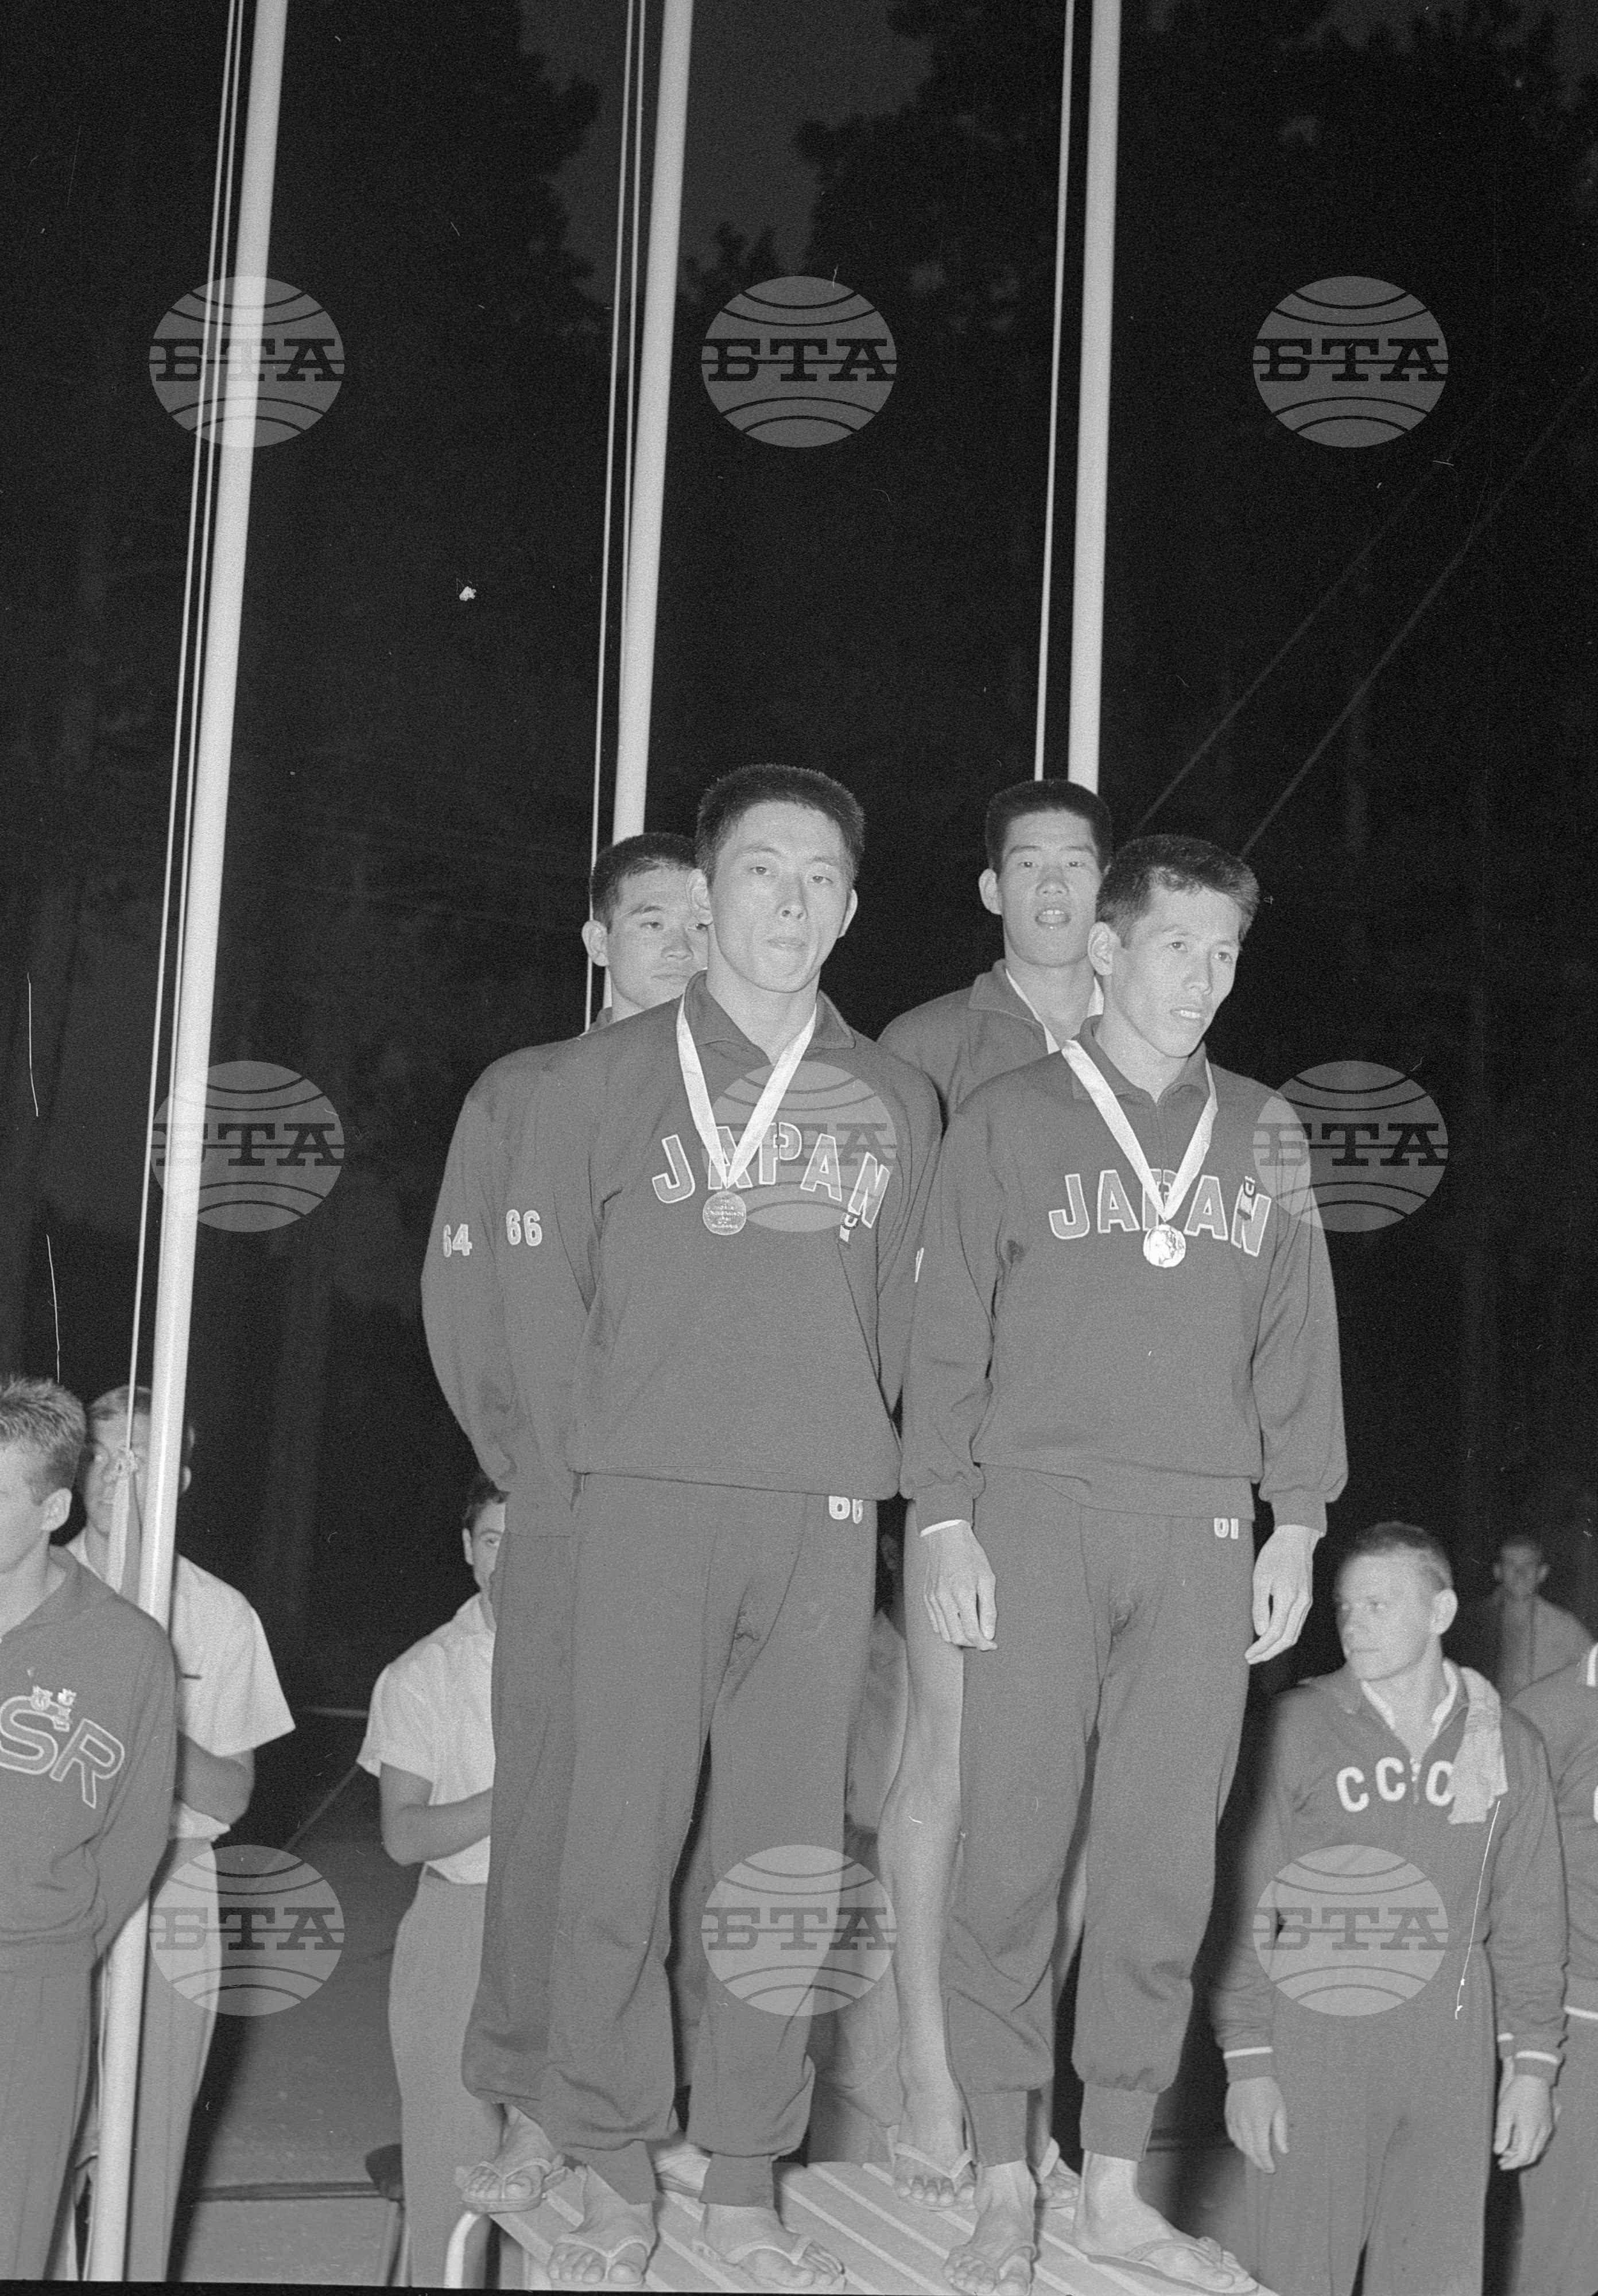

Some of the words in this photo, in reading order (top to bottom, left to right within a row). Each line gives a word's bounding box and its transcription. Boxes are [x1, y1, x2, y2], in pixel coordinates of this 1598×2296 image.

[652, 1122, 890, 1228] JAPAN
[443, 1223, 472, 1258] 64
[505, 1209, 542, 1246] 66
[1336, 1756, 1455, 1812] ССС
